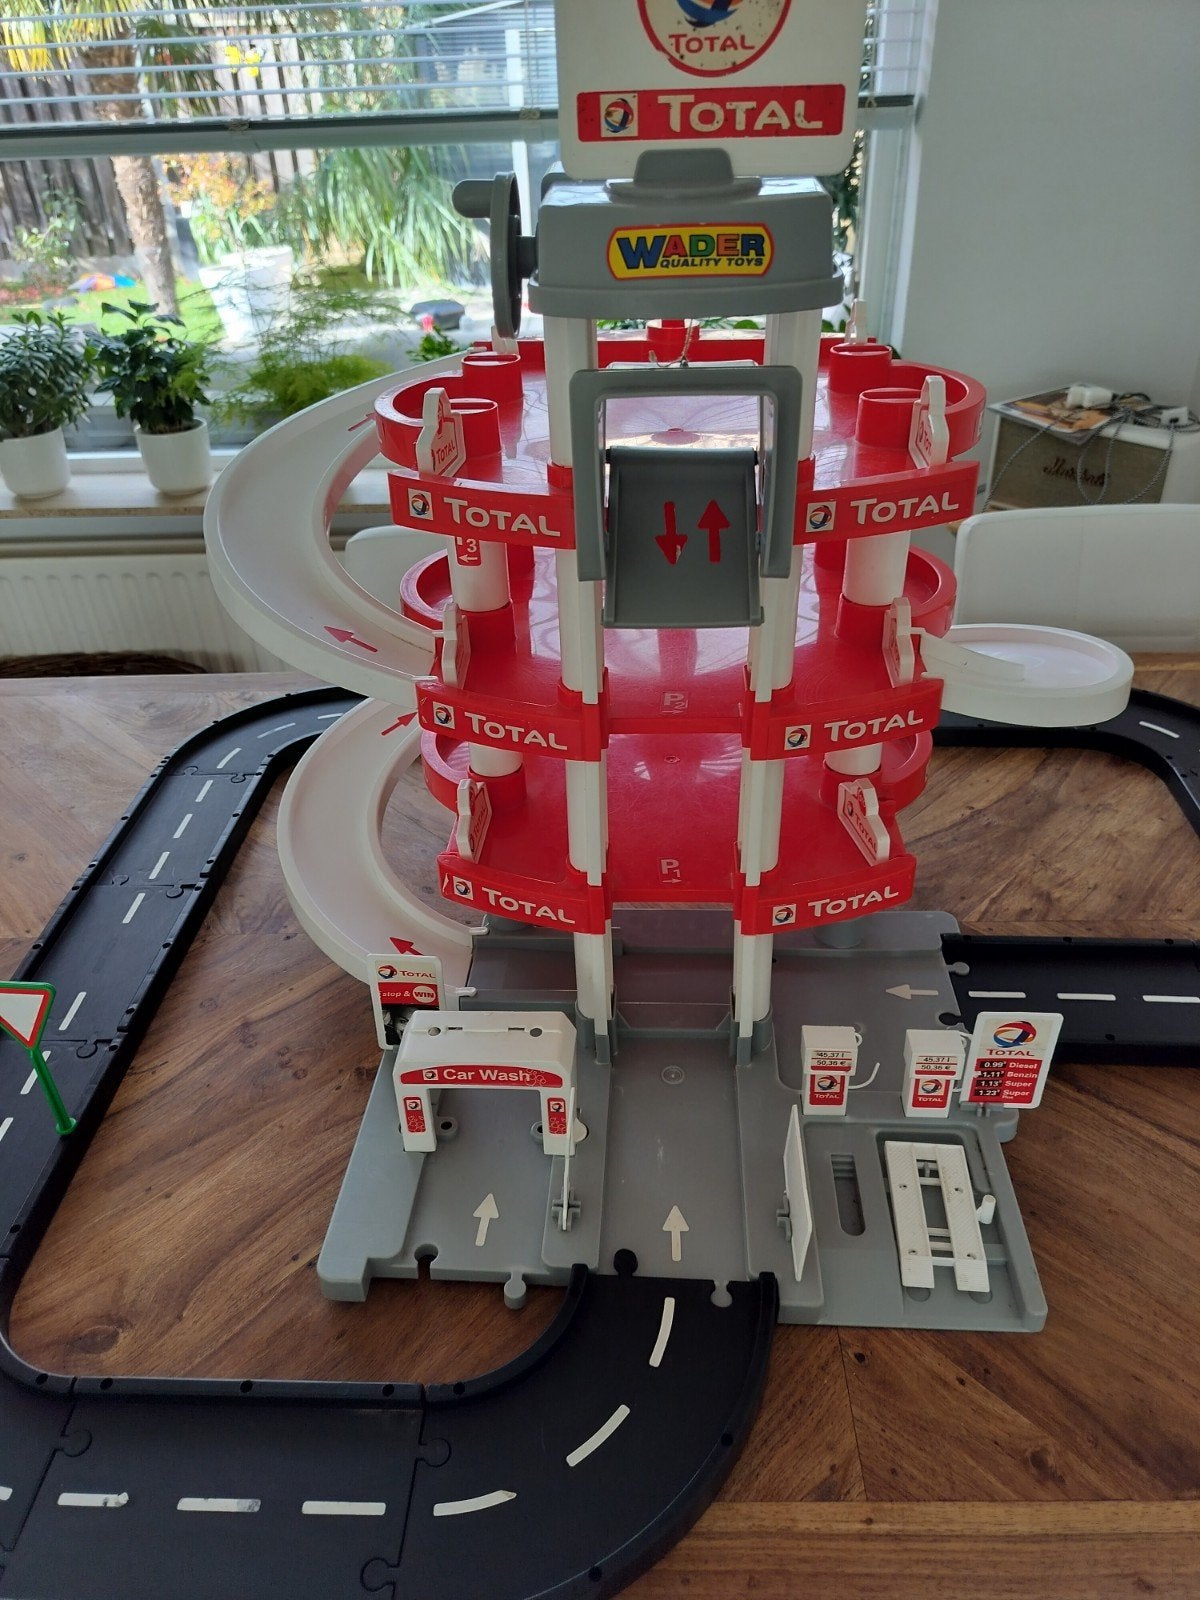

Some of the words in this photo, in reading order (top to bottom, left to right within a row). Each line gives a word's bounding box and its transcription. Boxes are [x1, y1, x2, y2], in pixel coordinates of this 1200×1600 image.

[668, 33, 756, 54] TOTAL
[657, 94, 823, 133] TOTAL
[616, 233, 766, 270] WADER
[660, 257, 721, 269] QUALITY
[727, 257, 764, 267] TOYS
[443, 496, 561, 538] TOTAL
[850, 491, 960, 525] TOTAL
[464, 711, 568, 751] TOTAL
[824, 710, 924, 742] TOTAL
[481, 886, 576, 925] TOTAL
[808, 885, 899, 917] TOTAL
[399, 970, 437, 979] TOTAL
[986, 1049, 1035, 1057] TOTAL
[443, 1068, 475, 1081] Car
[479, 1069, 531, 1082] Wash
